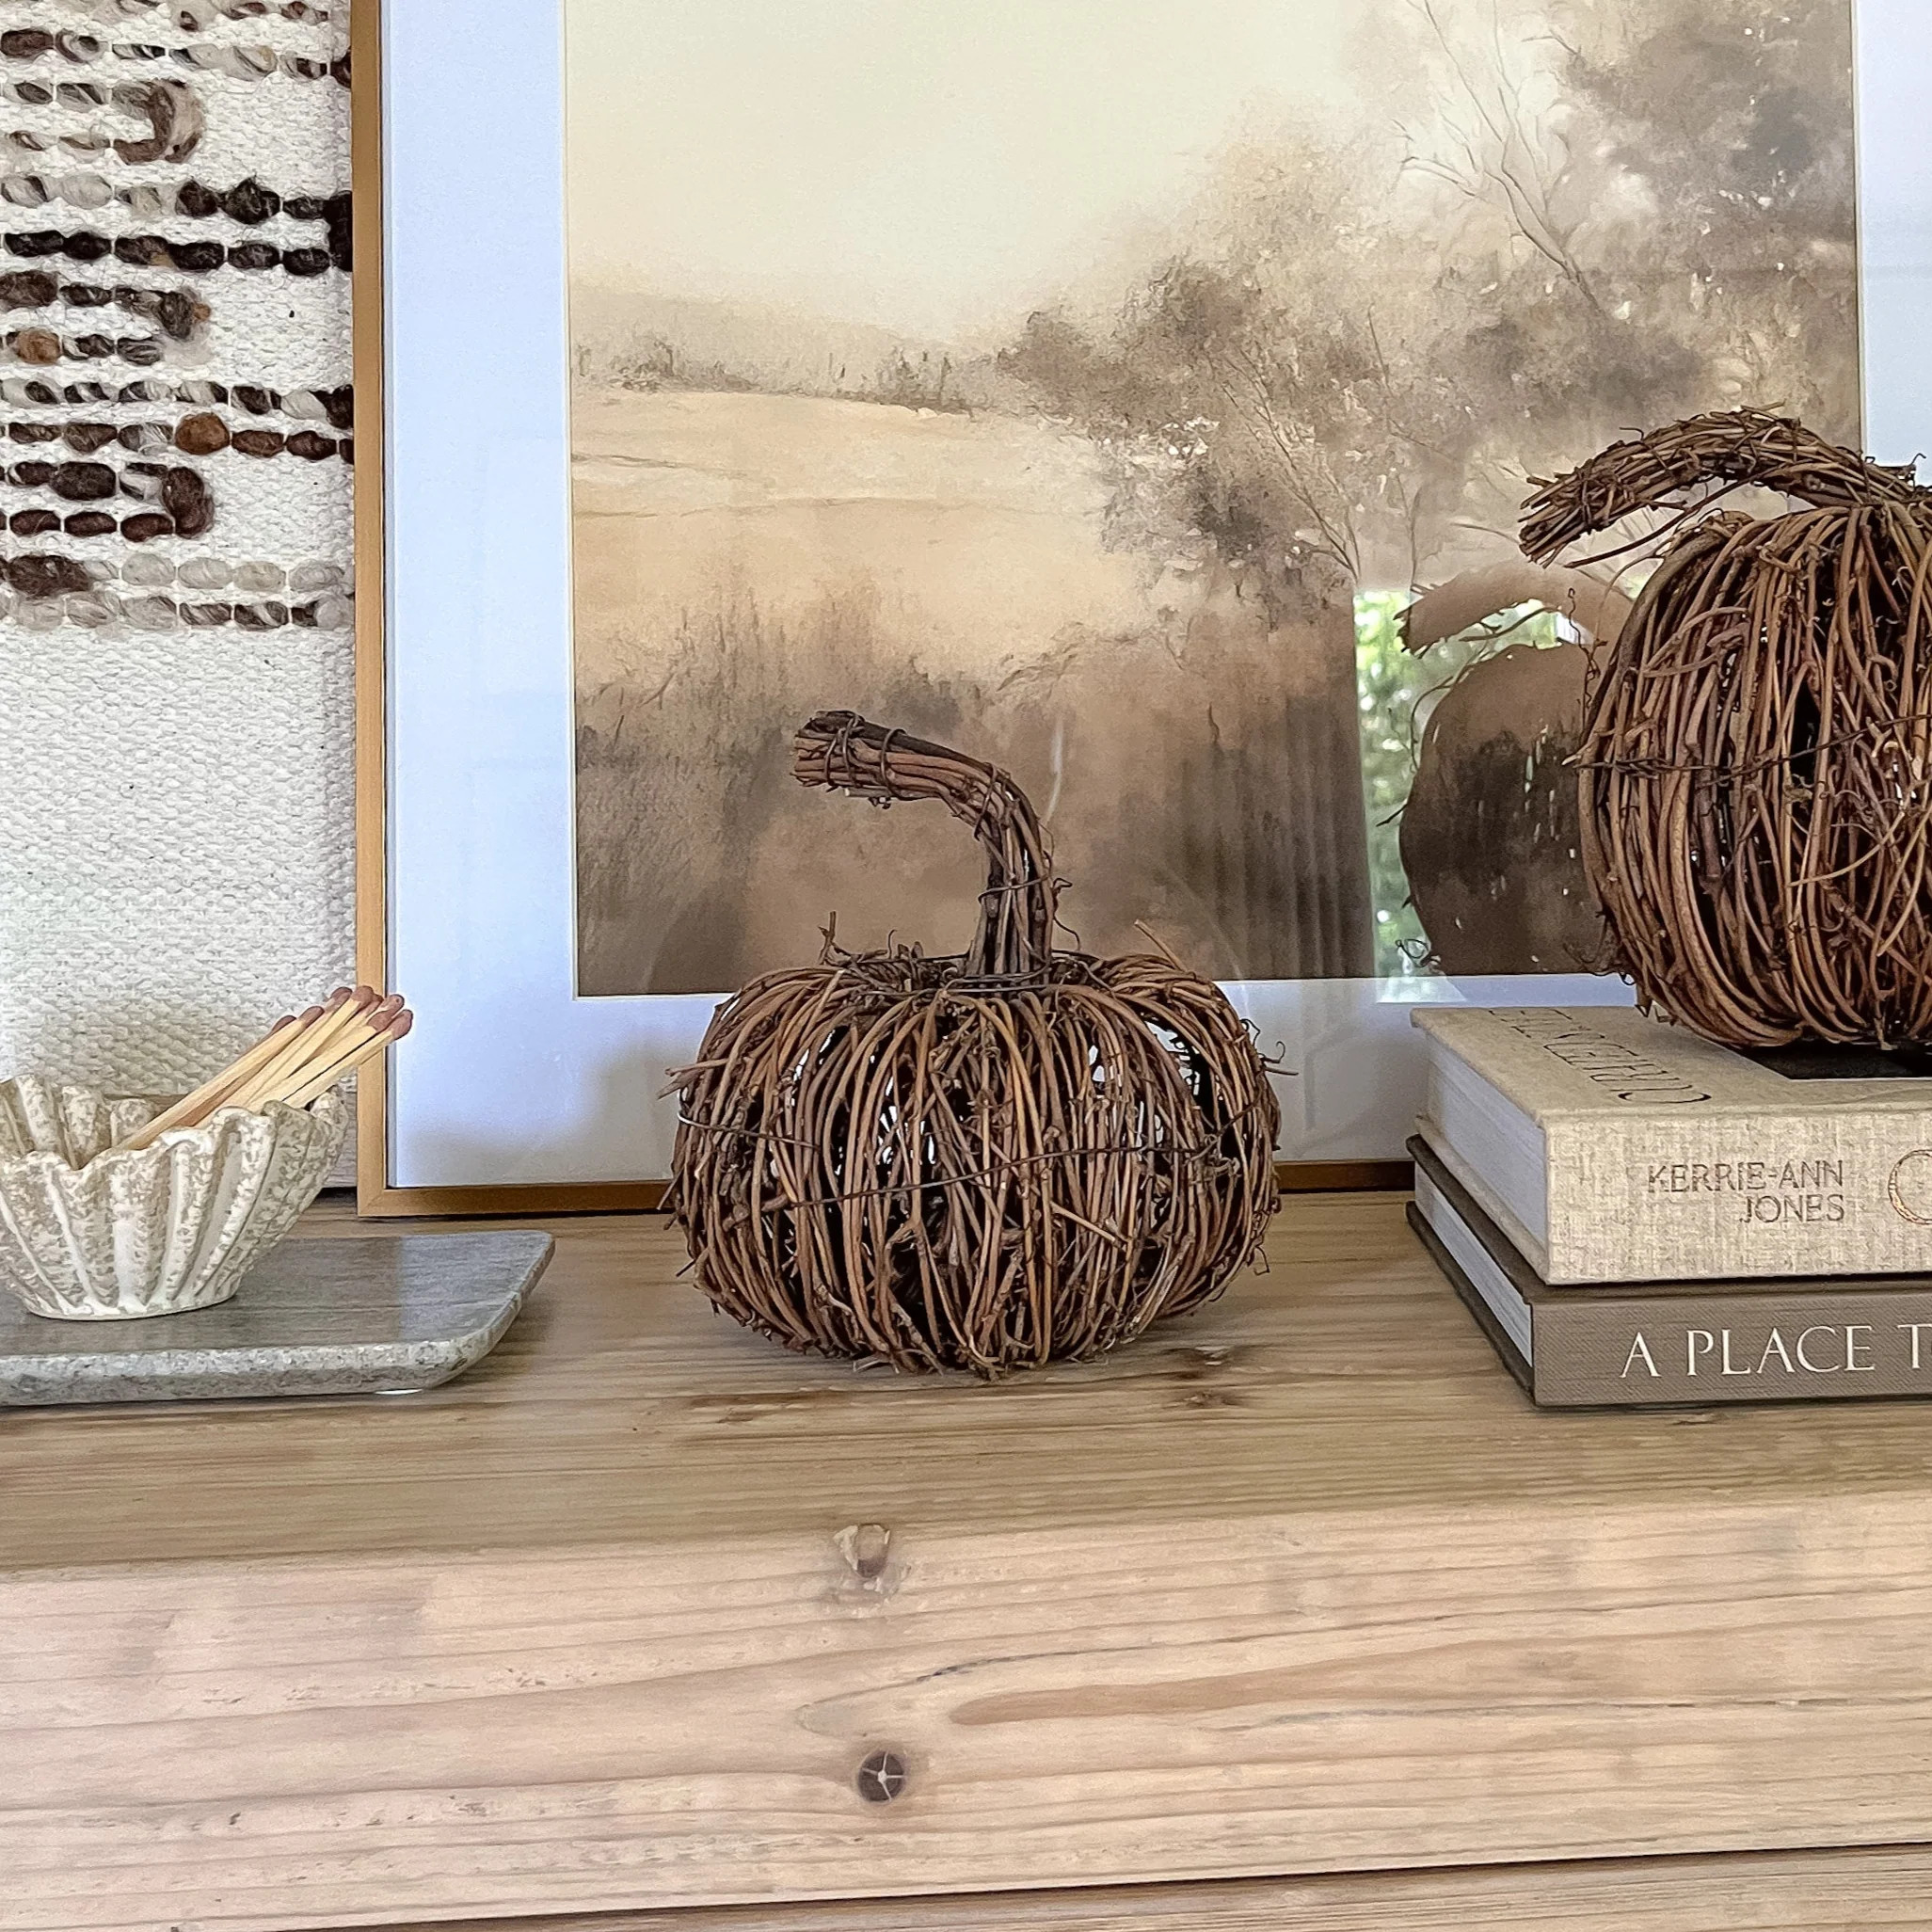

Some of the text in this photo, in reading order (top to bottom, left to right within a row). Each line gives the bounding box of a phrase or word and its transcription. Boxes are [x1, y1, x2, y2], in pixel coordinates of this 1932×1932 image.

[1647, 1159, 1844, 1193] KERRIE-ANN
[1739, 1193, 1845, 1223] JONES
[1619, 1332, 1662, 1378] A
[1686, 1325, 1876, 1376] PLACE
